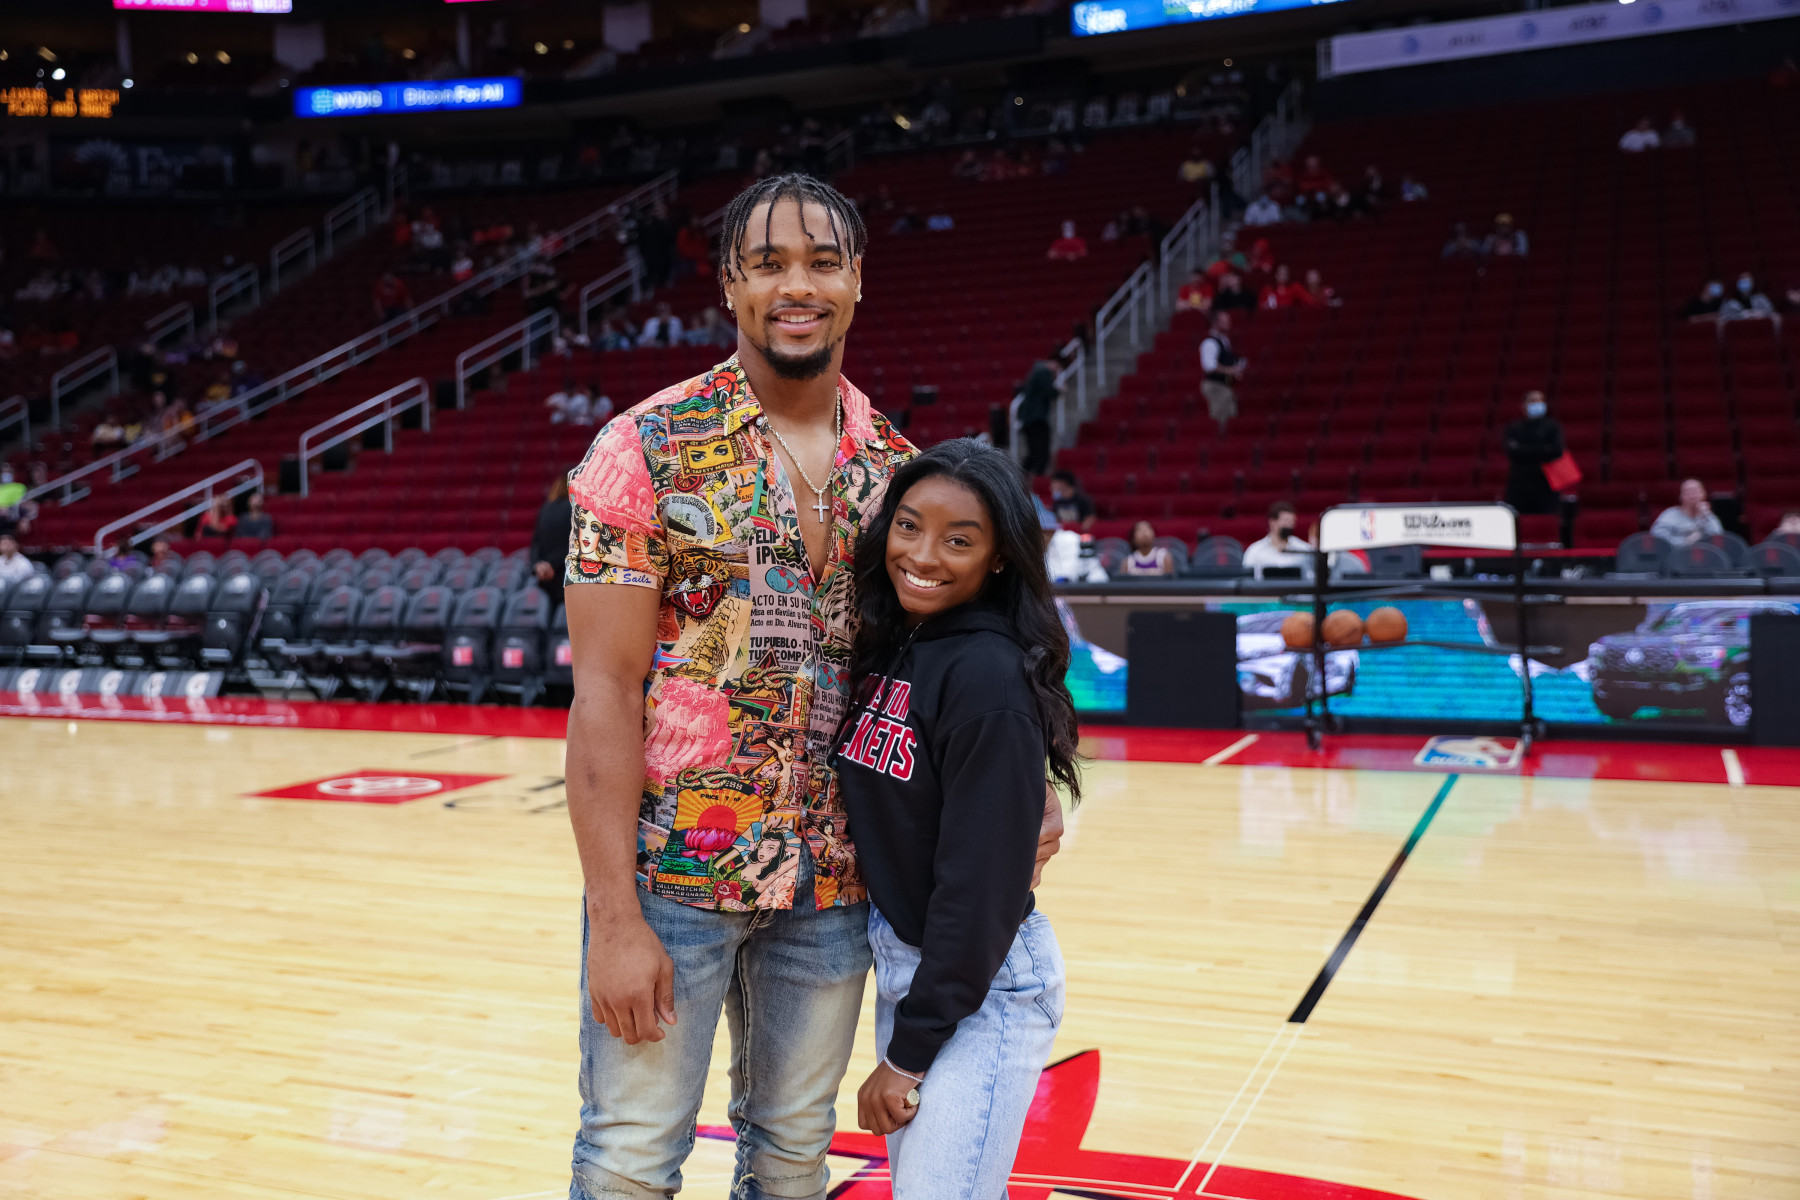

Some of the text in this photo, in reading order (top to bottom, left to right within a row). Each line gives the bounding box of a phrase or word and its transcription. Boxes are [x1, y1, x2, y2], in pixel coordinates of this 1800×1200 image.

[673, 409, 706, 420] SAFETY
[692, 462, 735, 475] SAFETY MATCH
[671, 495, 709, 514] STEAMSHIP
[704, 511, 715, 536] LINES
[1403, 513, 1473, 530] Wilson
[623, 573, 652, 584] Sails
[752, 594, 775, 607] ACTO
[777, 595, 788, 607] EN
[790, 597, 800, 609] SU
[750, 608, 765, 617] Misa
[750, 619, 764, 627] Acto
[750, 636, 812, 651] TU PUEBLO TU
[657, 873, 693, 885] SAFETY
[674, 884, 697, 892] MATCH
